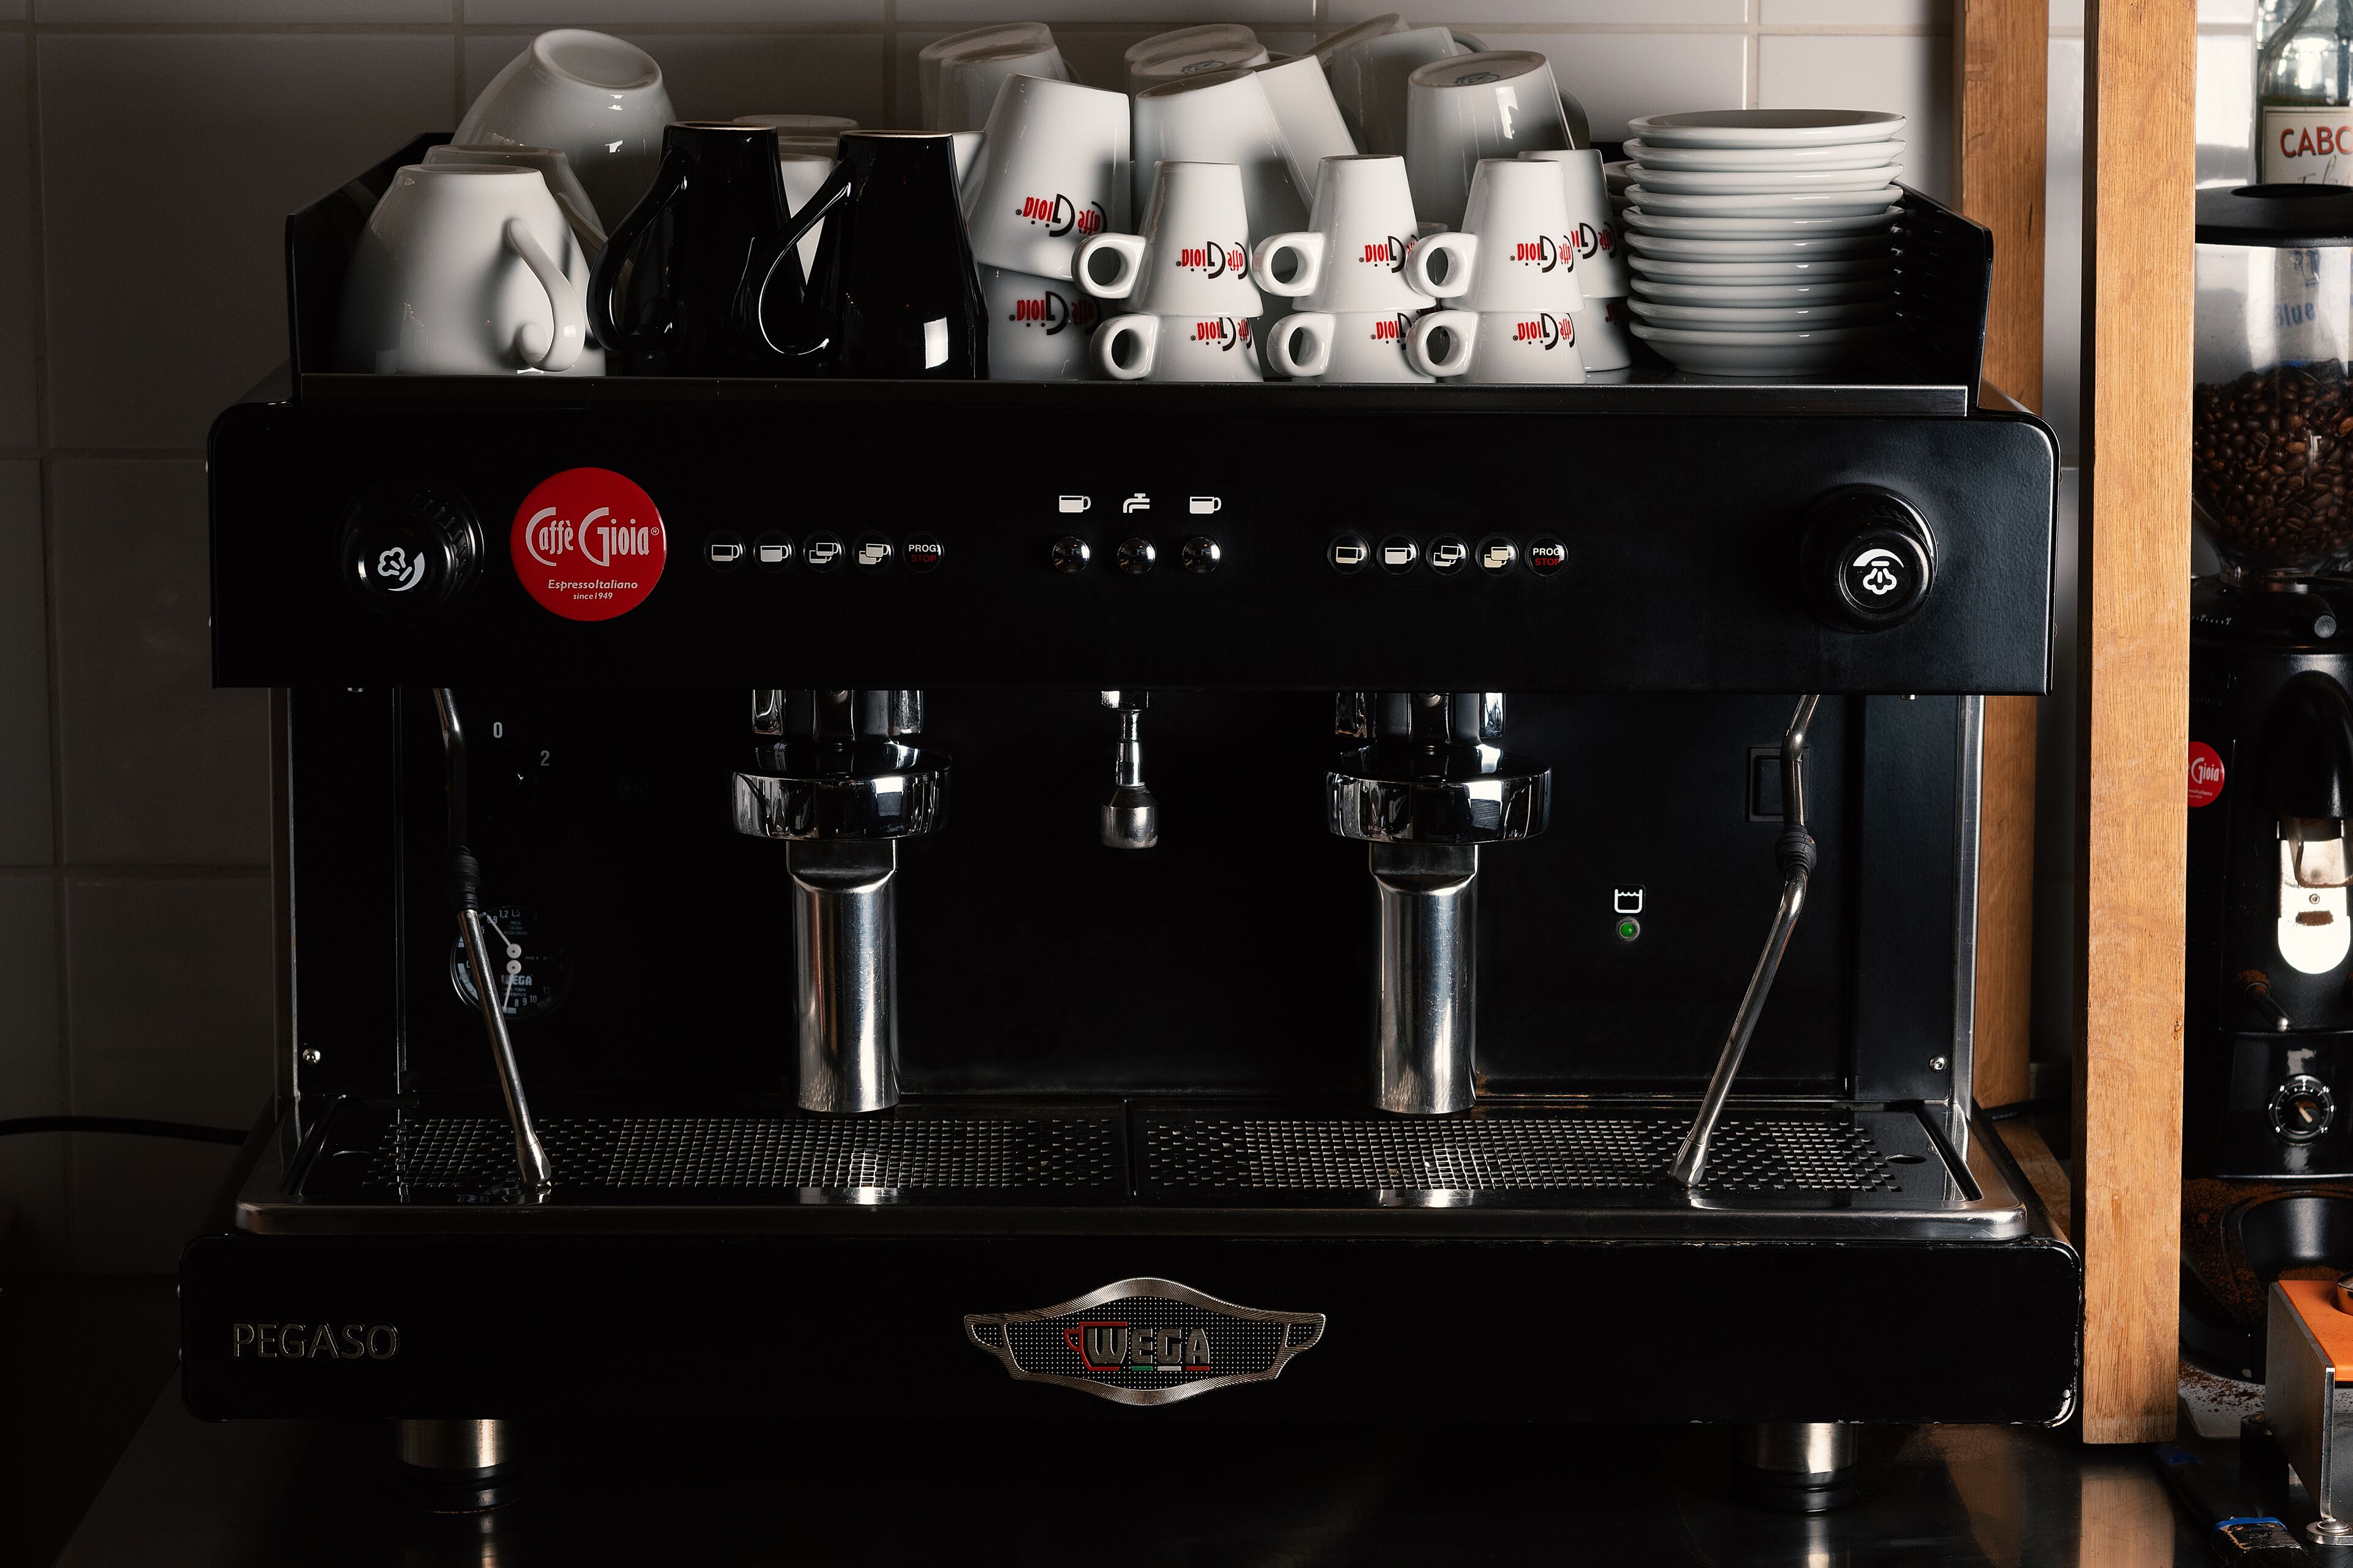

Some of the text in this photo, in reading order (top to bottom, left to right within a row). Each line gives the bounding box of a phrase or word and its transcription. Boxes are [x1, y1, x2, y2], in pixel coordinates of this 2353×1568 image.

[525, 506, 574, 567] Caffè
[911, 554, 937, 562] STOP
[493, 722, 503, 738] 0
[540, 750, 550, 767] 2
[514, 999, 520, 1007] 8
[522, 997, 528, 1006] 9
[232, 1322, 400, 1361] PEGASO
[1085, 1327, 1211, 1365] WEGA
